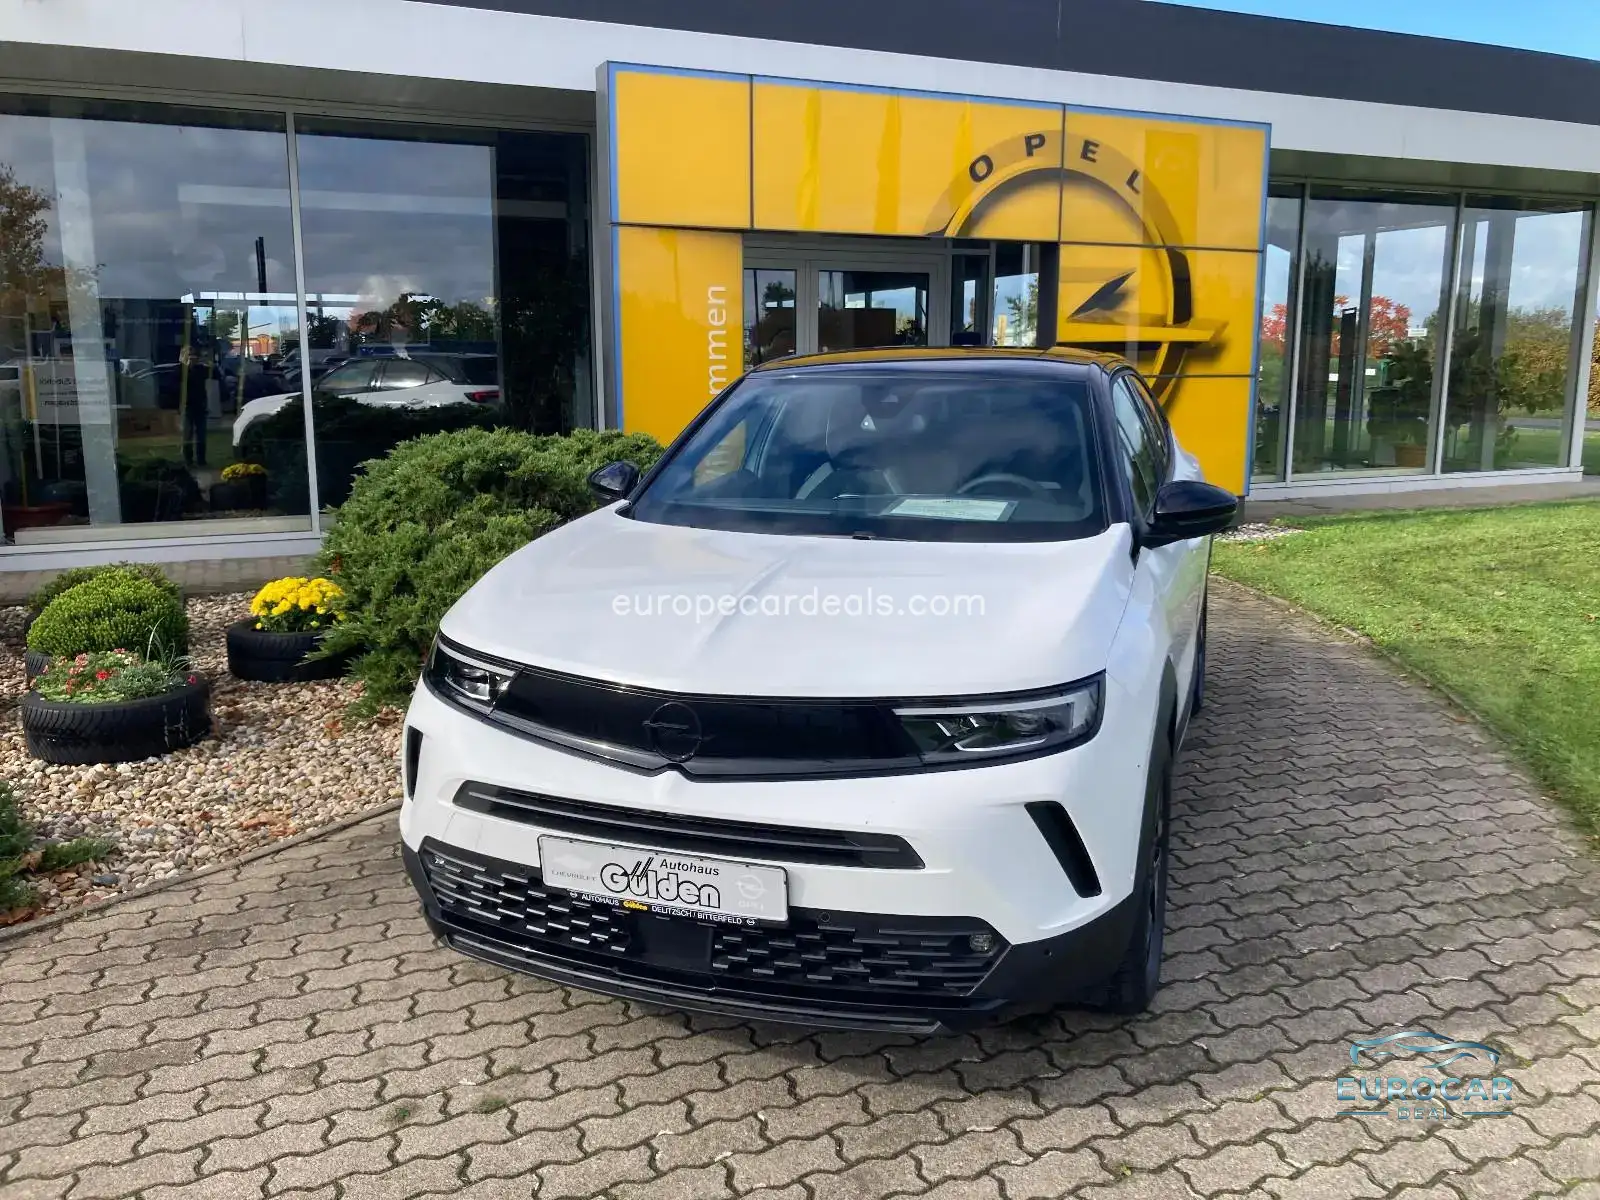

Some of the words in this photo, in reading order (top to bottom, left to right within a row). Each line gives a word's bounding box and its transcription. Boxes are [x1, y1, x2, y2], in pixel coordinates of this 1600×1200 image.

[969, 133, 1140, 195] OPEL
[707, 285, 727, 396] mmen
[660, 858, 720, 876] Autohaus
[581, 894, 620, 906] AUTOHAUS
[651, 905, 692, 918] DELITZSCH
[697, 912, 742, 925] BITTERFELD
